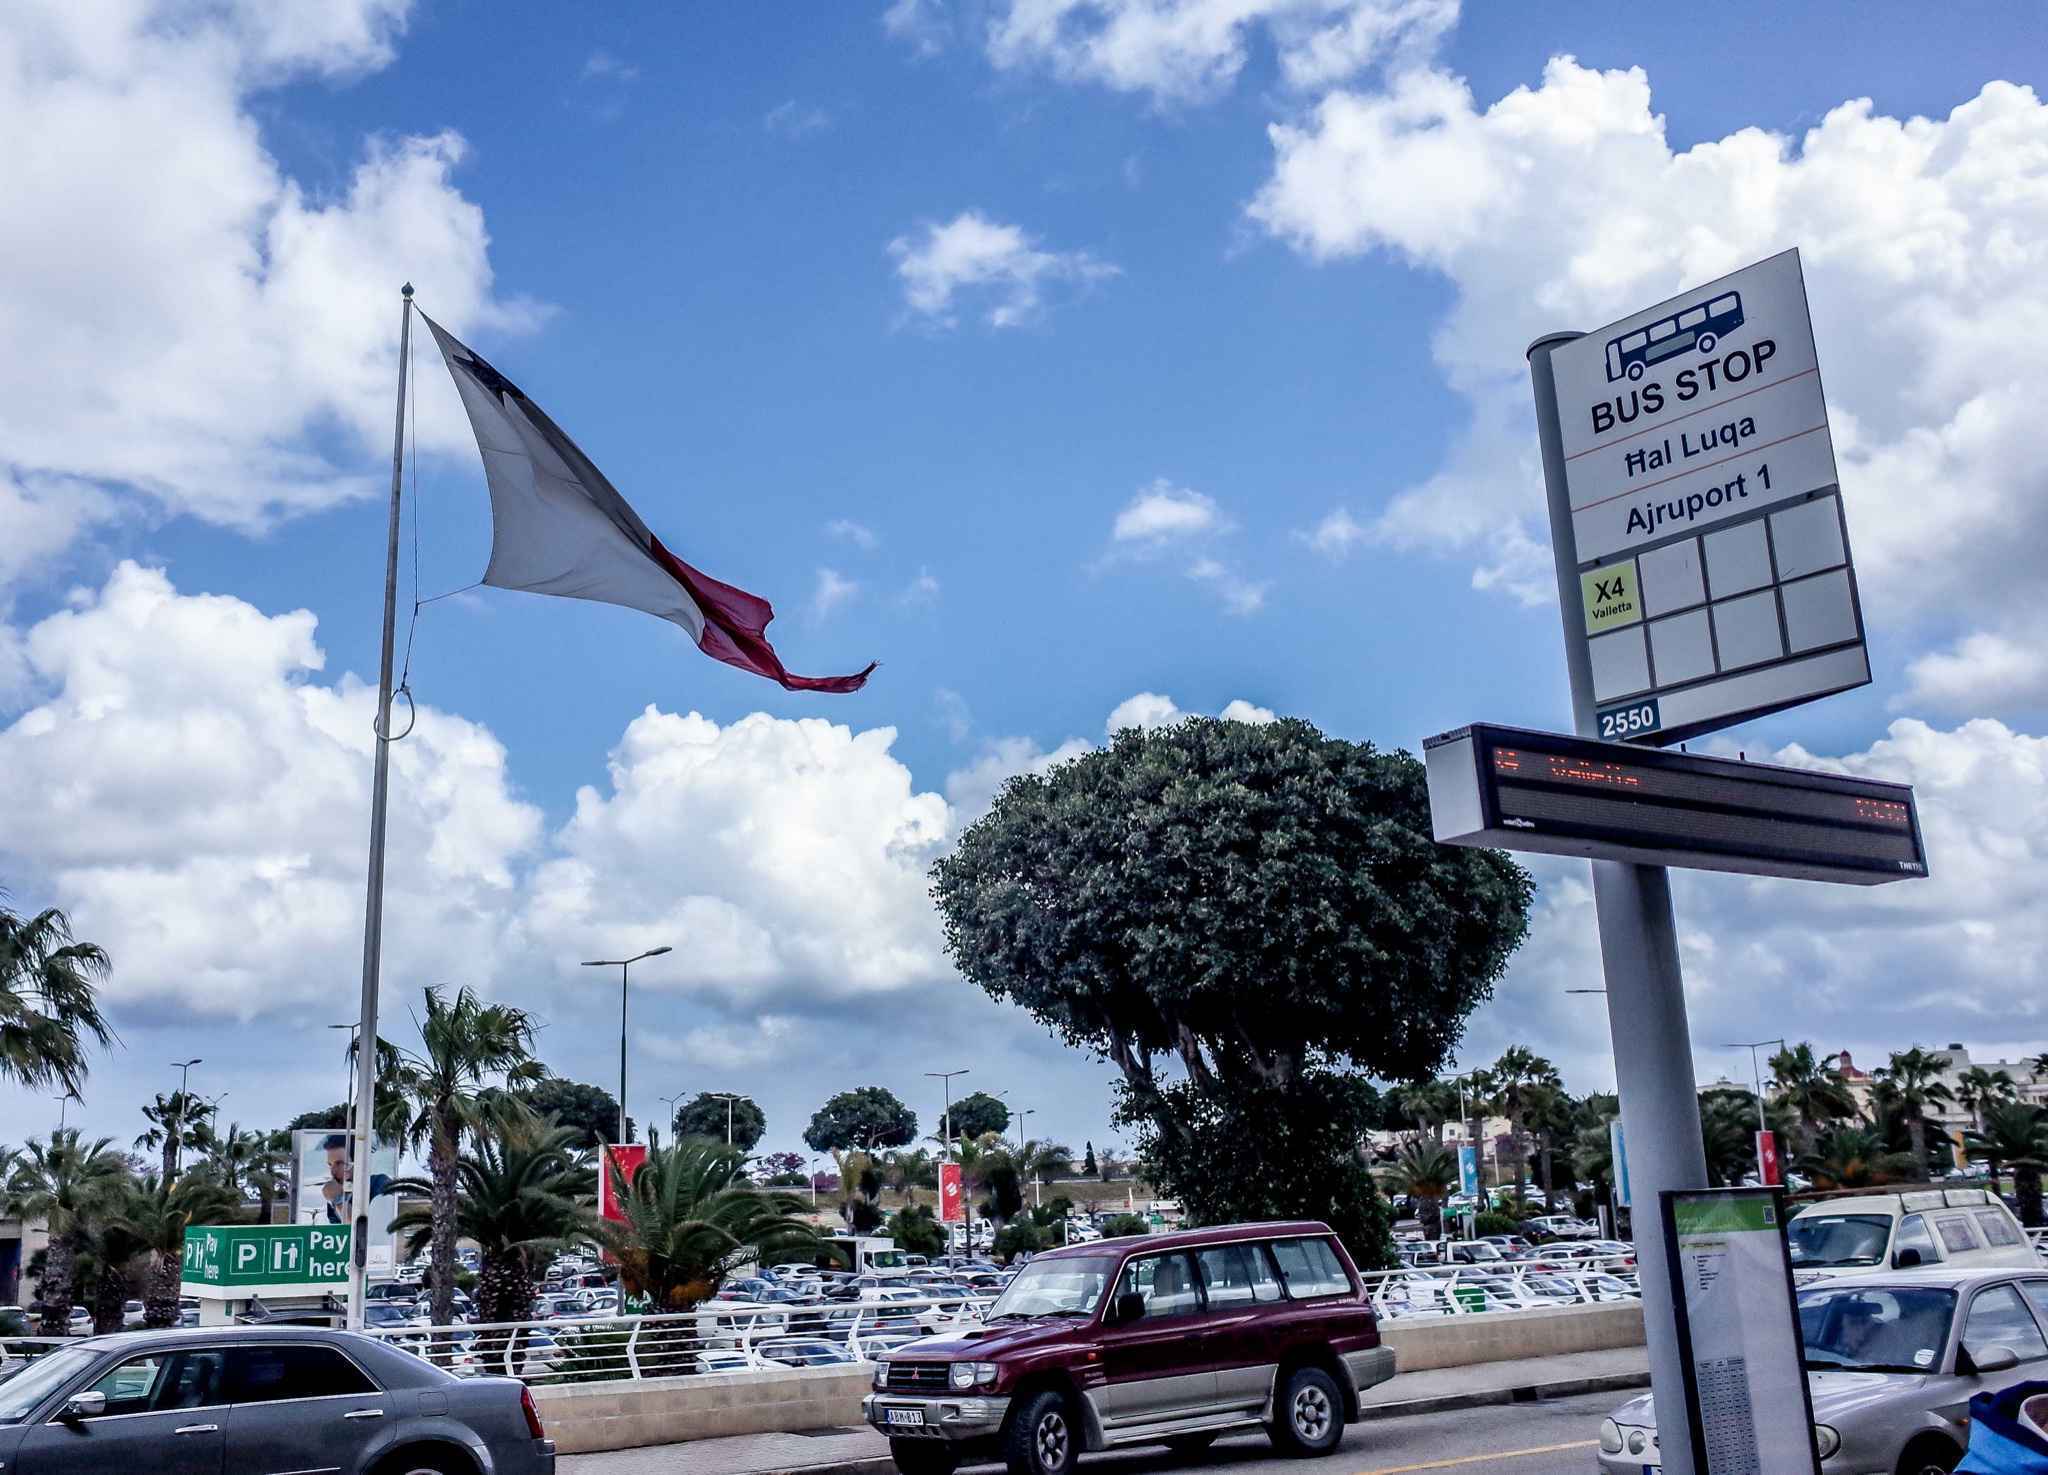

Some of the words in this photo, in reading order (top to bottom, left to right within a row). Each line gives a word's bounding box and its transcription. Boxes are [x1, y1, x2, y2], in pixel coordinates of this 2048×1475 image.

[1591, 381, 1665, 434] BUS
[1676, 339, 1777, 402] STOP
[1624, 438, 1672, 478] Ħal
[1680, 416, 1757, 458] Luqa
[1626, 472, 1749, 535] Ajruport
[1756, 464, 1772, 490] 1
[1595, 577, 1625, 604] X4
[1592, 599, 1632, 621] Valletta
[1601, 705, 1654, 739] 2550
[206, 1233, 218, 1258] Pay
[310, 1231, 349, 1254] Pay
[204, 1259, 219, 1280] here
[238, 1244, 257, 1270] P
